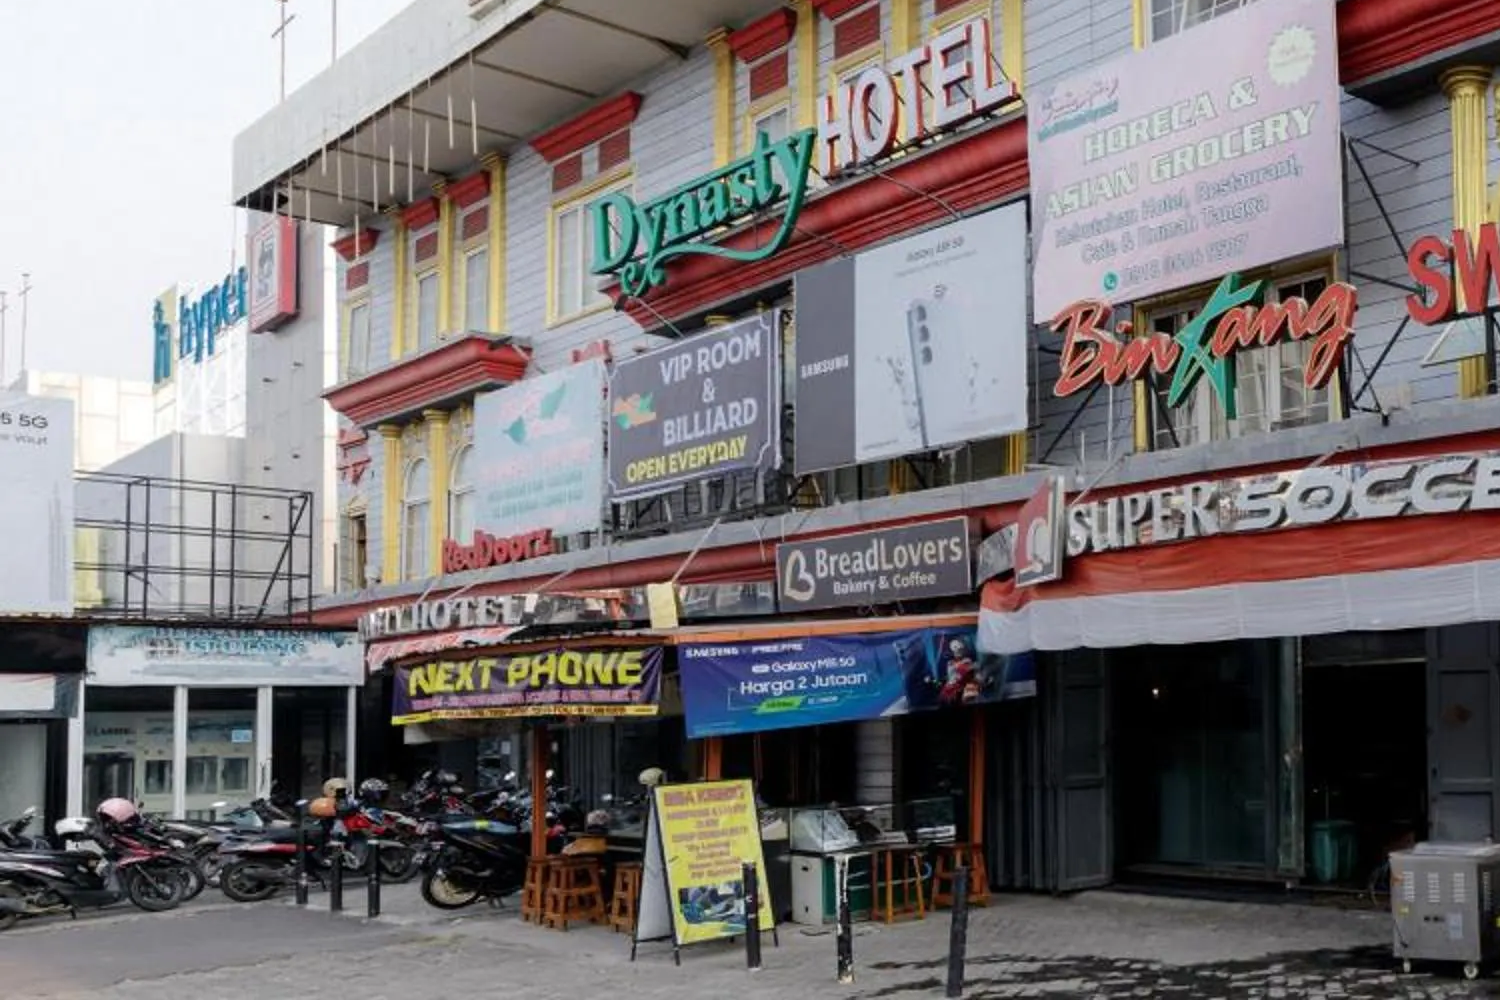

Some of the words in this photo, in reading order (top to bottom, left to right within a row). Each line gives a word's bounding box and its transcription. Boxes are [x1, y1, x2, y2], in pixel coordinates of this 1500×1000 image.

[817, 18, 1019, 180] HOTEL
[1084, 91, 1216, 163] HORECA
[1227, 76, 1259, 111] &
[1044, 162, 1140, 220] ASIAN
[1149, 102, 1318, 184] GROCERY
[592, 127, 817, 297] Dynasty
[660, 353, 692, 385] VIP
[697, 329, 762, 375] ROOM
[800, 354, 849, 380] SAMSUNG
[702, 377, 716, 403] &
[662, 397, 758, 446] BILLIARD
[626, 455, 665, 483] OPEN
[669, 435, 748, 474] EVERYDAY
[1066, 481, 1220, 557] SUPER
[815, 536, 963, 578] BreadLovers
[833, 577, 877, 596] Bakery
[878, 575, 889, 590] &
[893, 571, 937, 588] Coffee
[408, 658, 500, 697] NEXT
[507, 650, 644, 688] PHONE
[740, 679, 795, 696] Harga
[798, 675, 807, 689] 2
[811, 671, 868, 688] Jutaan
[771, 660, 816, 673] Galaxy
